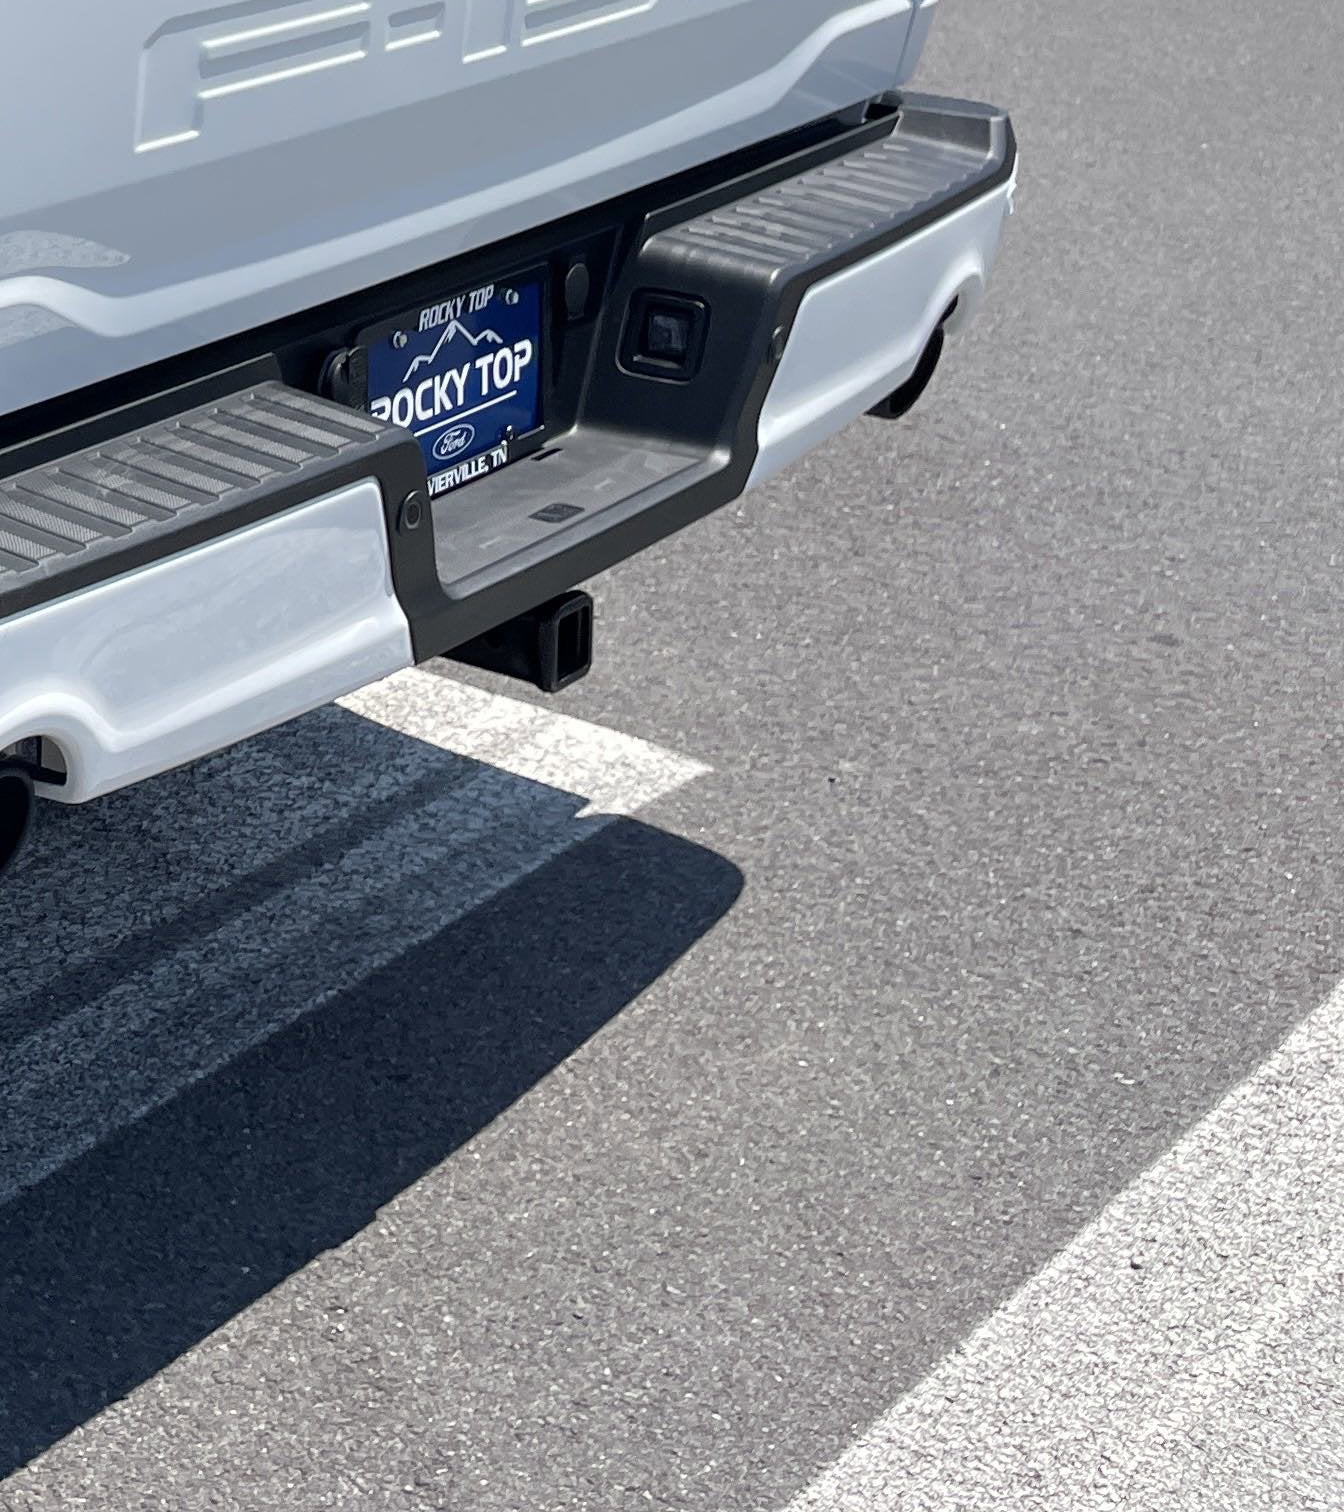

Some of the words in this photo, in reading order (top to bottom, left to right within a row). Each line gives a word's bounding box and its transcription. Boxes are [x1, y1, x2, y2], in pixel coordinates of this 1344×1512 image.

[418, 294, 466, 332] ROCKY
[469, 284, 494, 313] TOP
[475, 339, 532, 396] TOP
[440, 429, 467, 455] Ford
[427, 455, 489, 497] VIERVILLE,
[491, 446, 508, 468] TN
